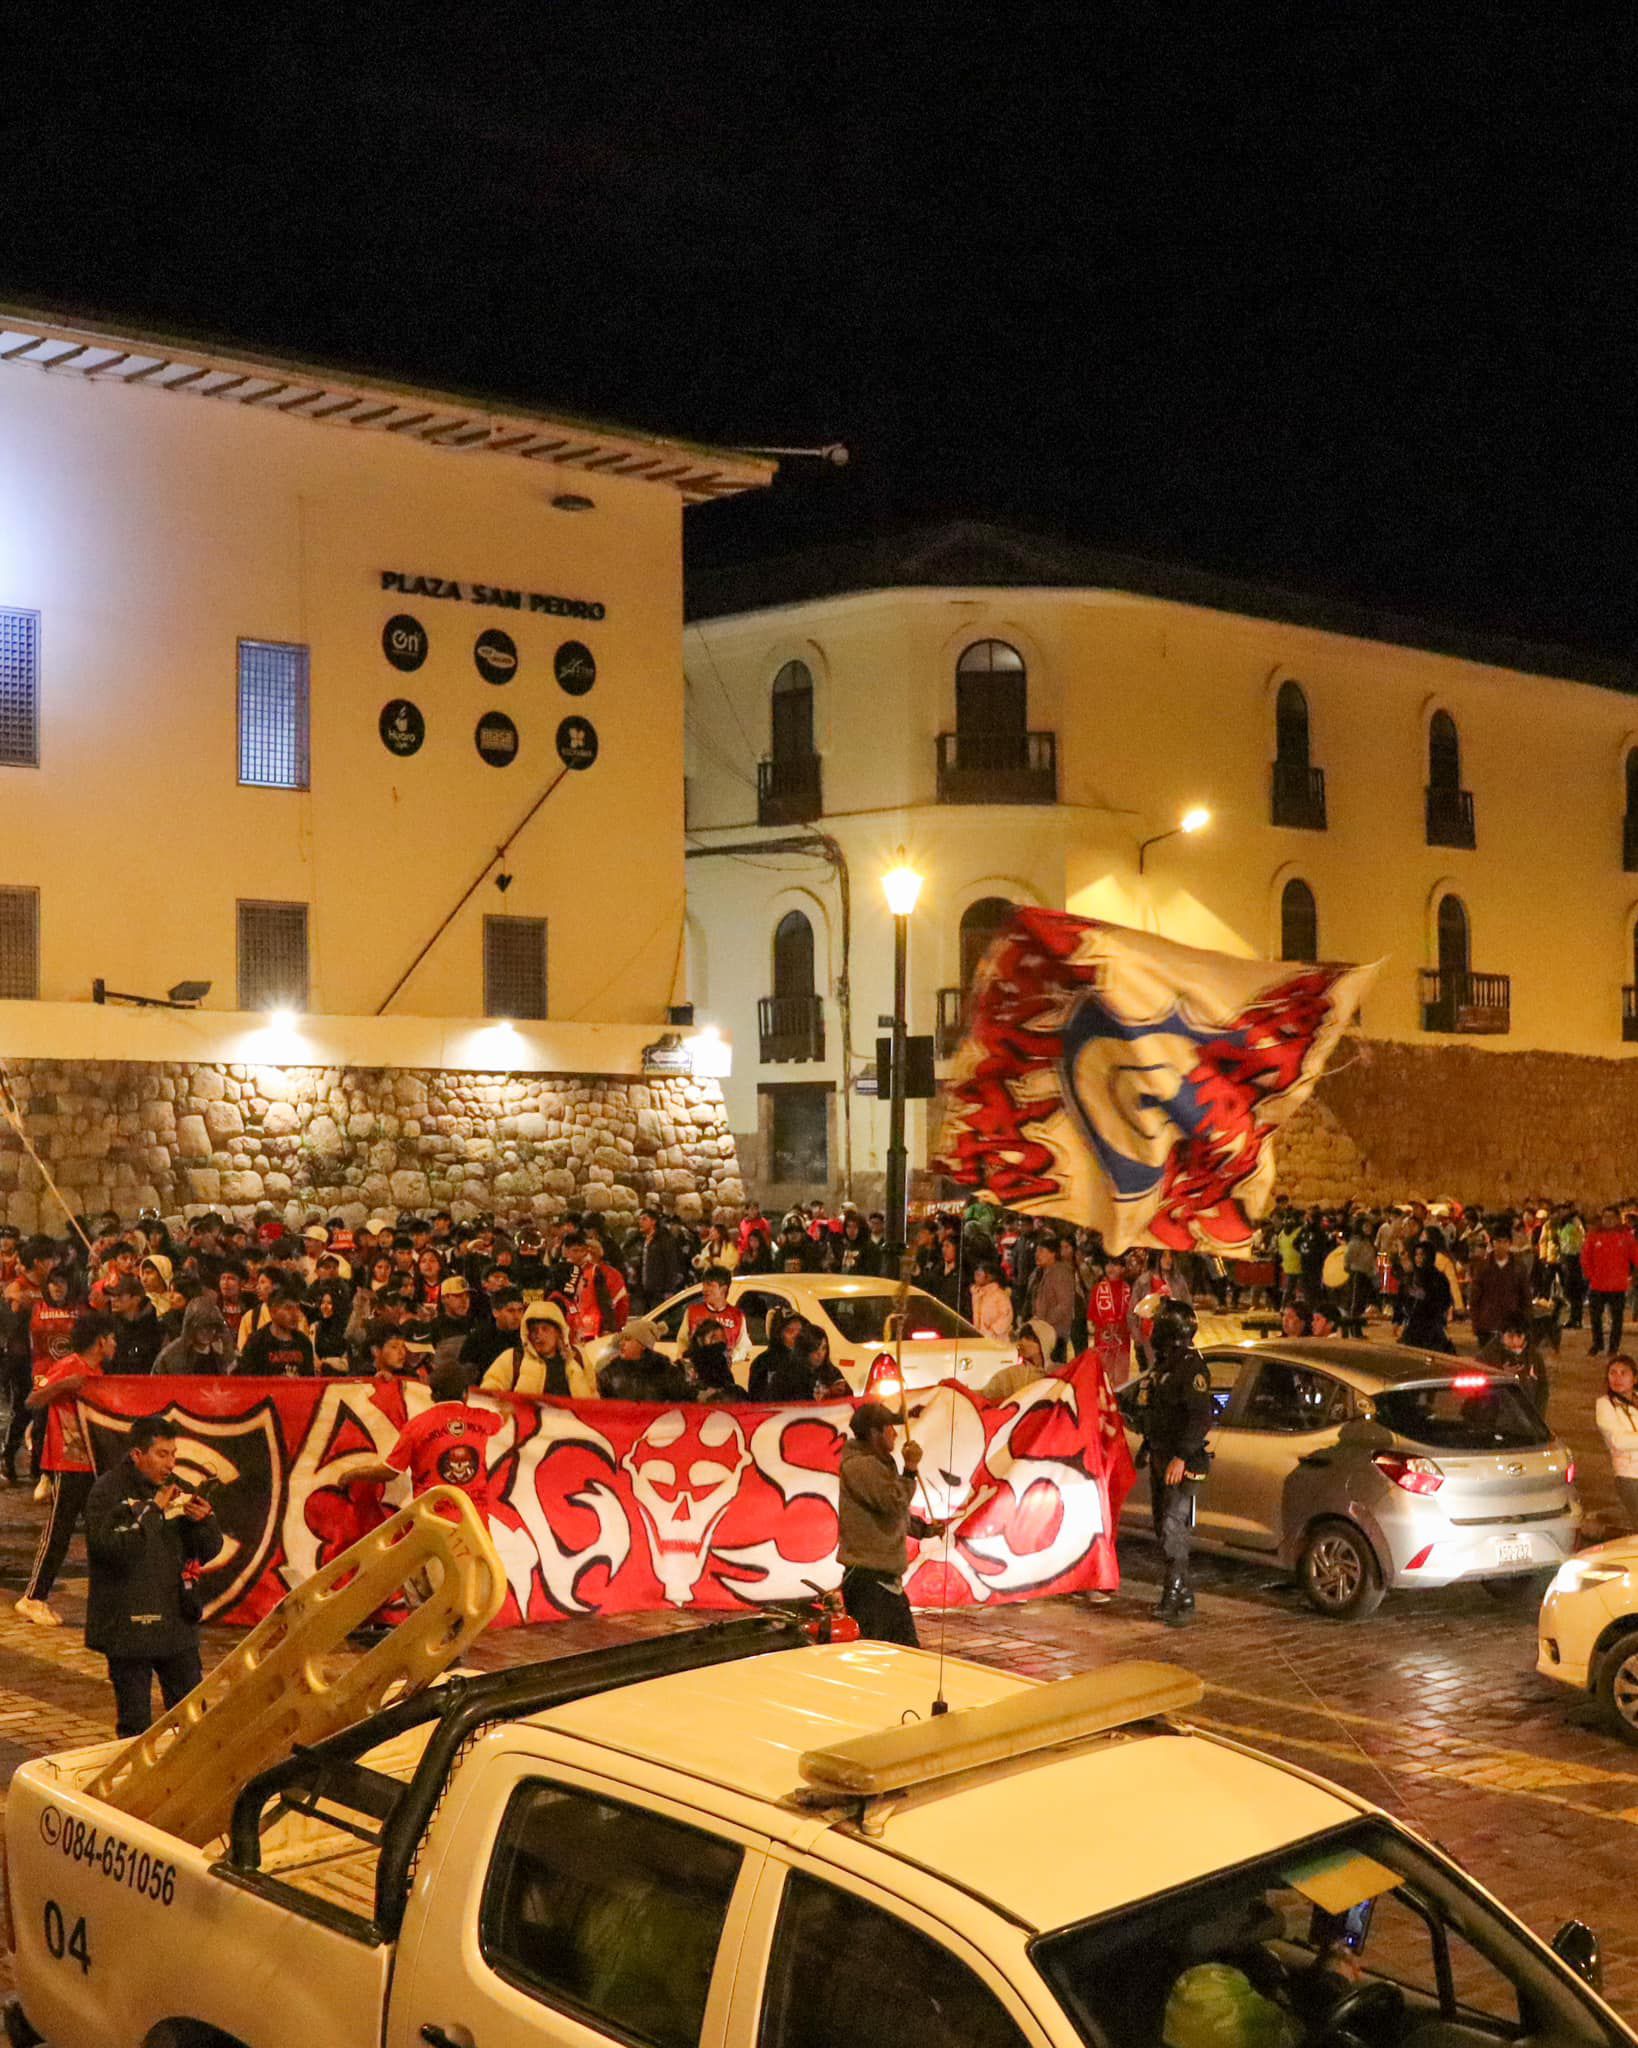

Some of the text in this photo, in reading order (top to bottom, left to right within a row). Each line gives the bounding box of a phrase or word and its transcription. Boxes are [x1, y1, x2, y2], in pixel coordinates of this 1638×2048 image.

[381, 571, 606, 621] PLAZA SAN PEDRO
[62, 1815, 176, 1906] 084-651056
[44, 1900, 91, 1975] 04
